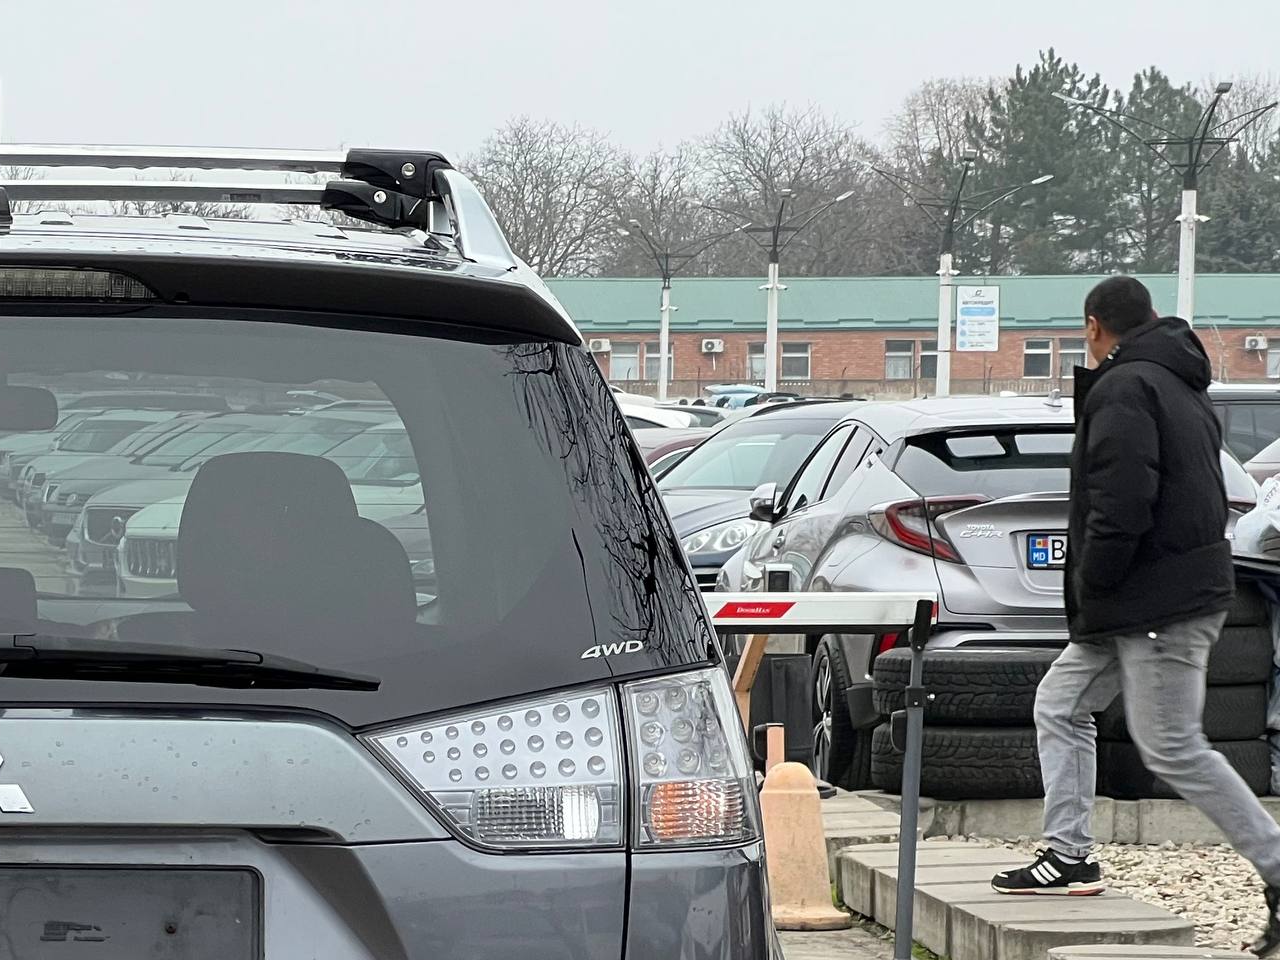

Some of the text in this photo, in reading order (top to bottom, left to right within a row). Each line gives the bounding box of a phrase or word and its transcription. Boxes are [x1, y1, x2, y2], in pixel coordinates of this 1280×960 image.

[966, 523, 995, 531] TOYOTA
[1033, 551, 1046, 561] MD
[580, 640, 644, 659] 4WD
